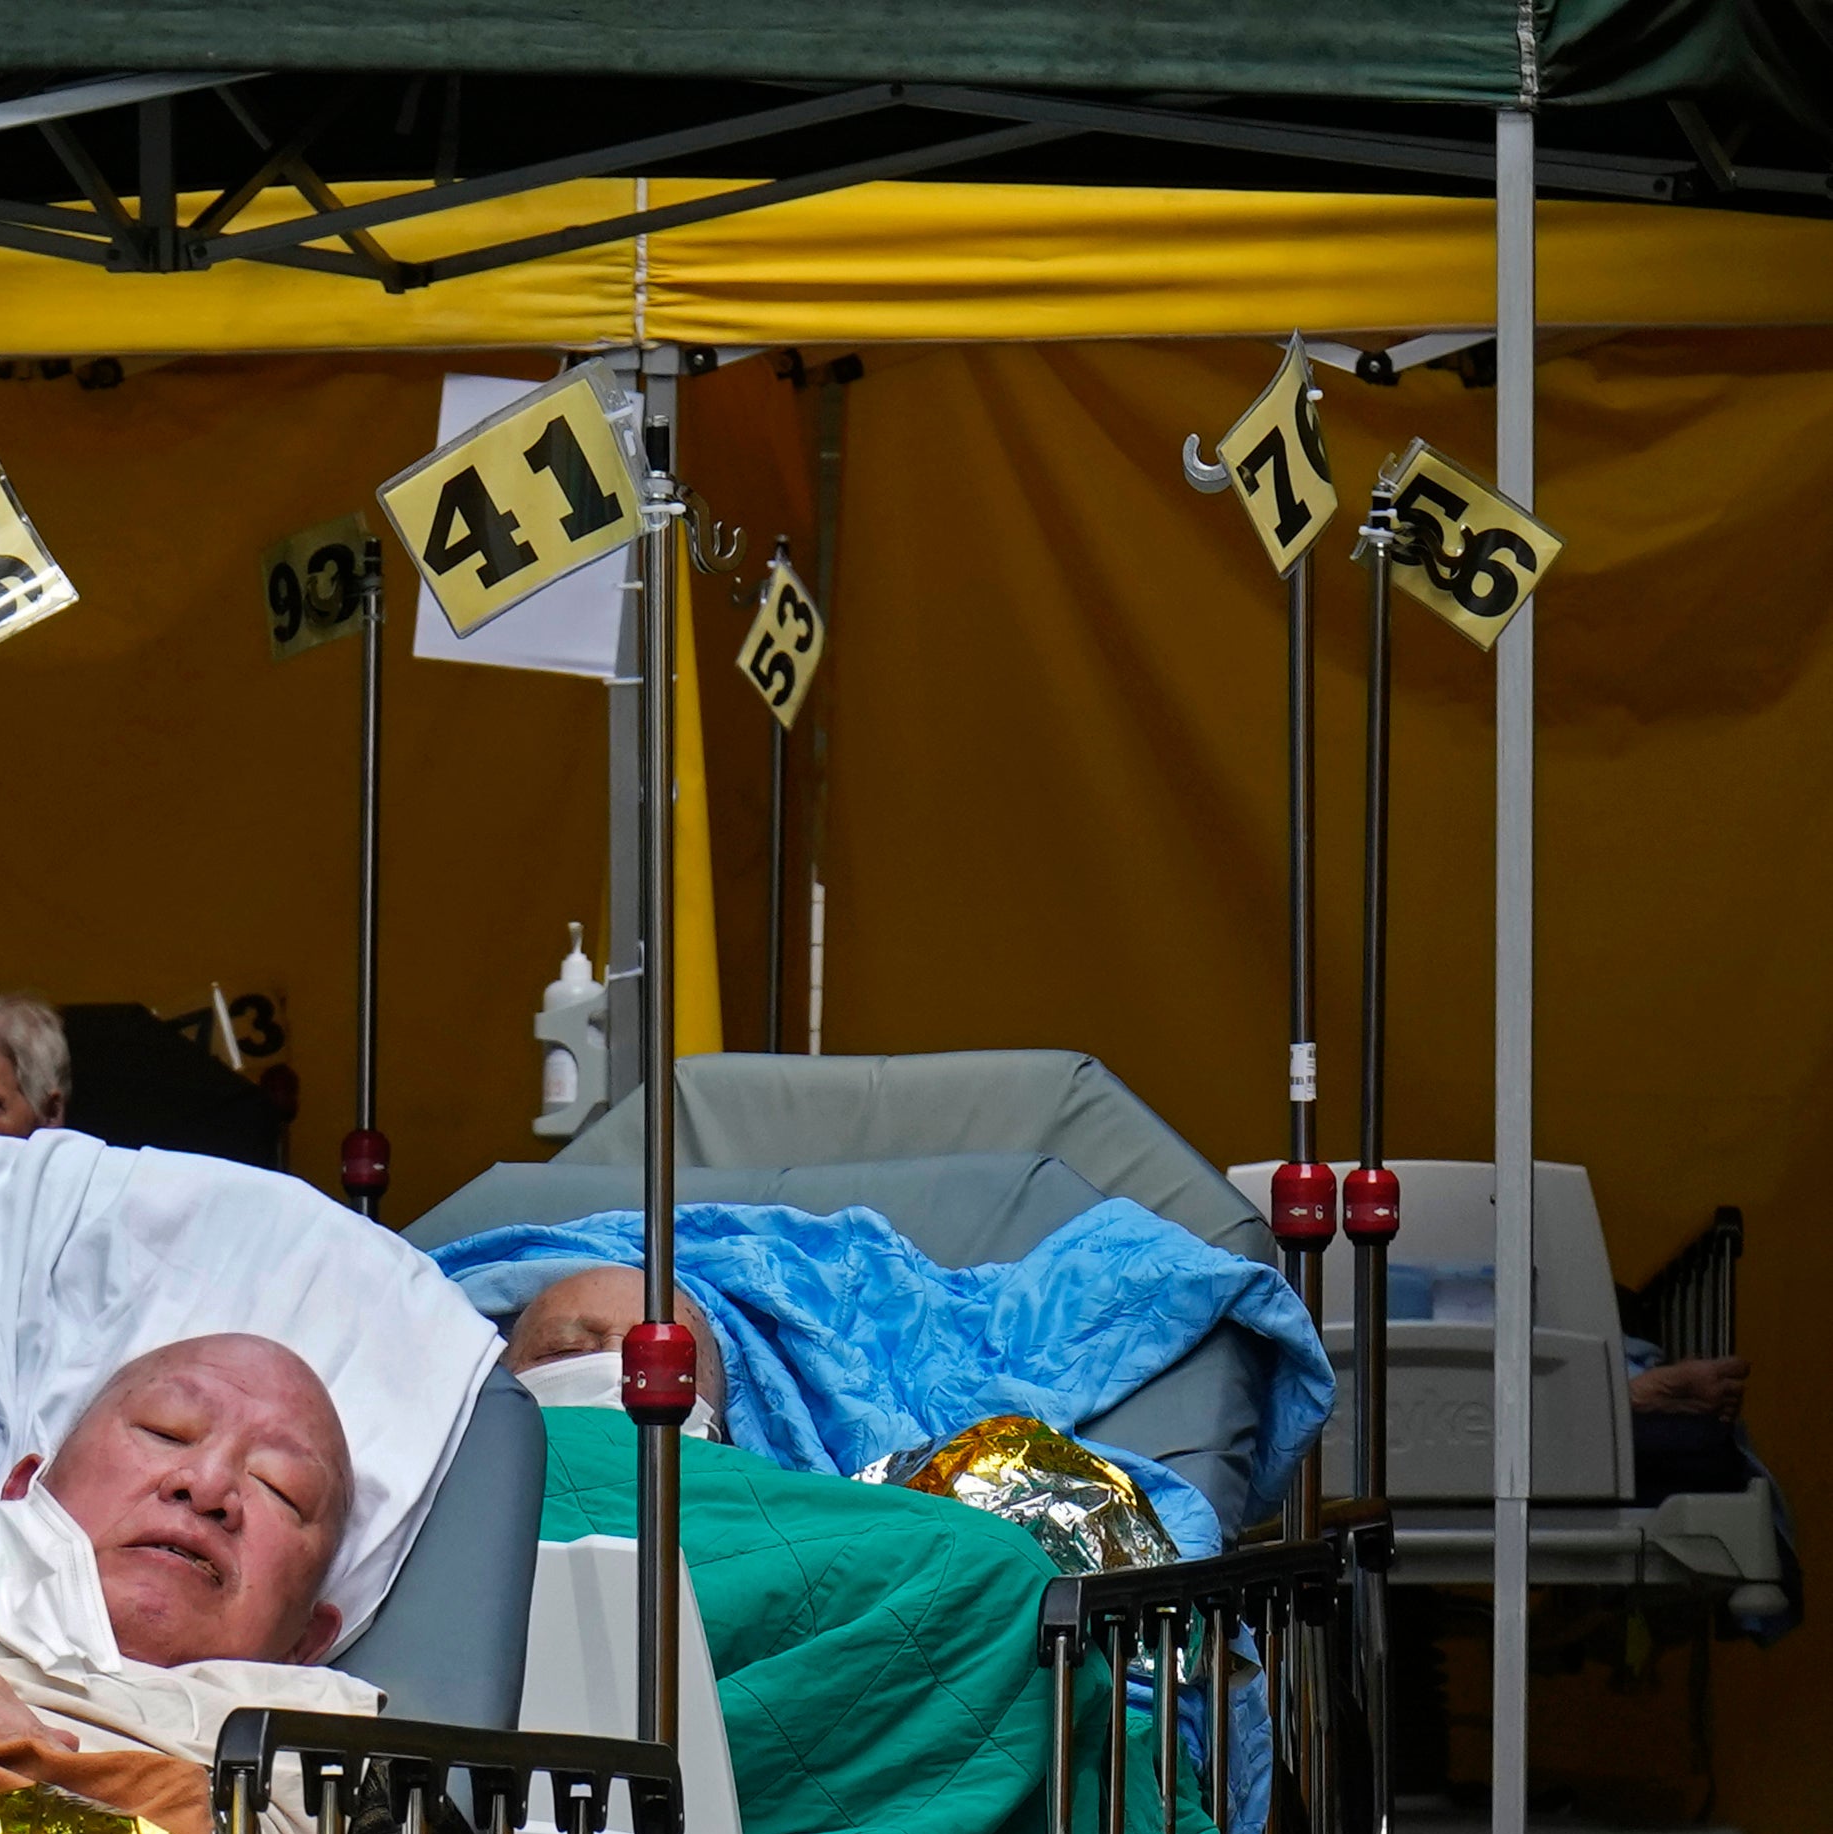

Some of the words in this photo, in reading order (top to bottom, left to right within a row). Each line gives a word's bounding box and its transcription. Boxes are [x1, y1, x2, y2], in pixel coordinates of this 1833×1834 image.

[422, 414, 624, 590] 41
[1392, 472, 1537, 617] 56
[269, 543, 360, 642] 93
[749, 583, 815, 706] 53
